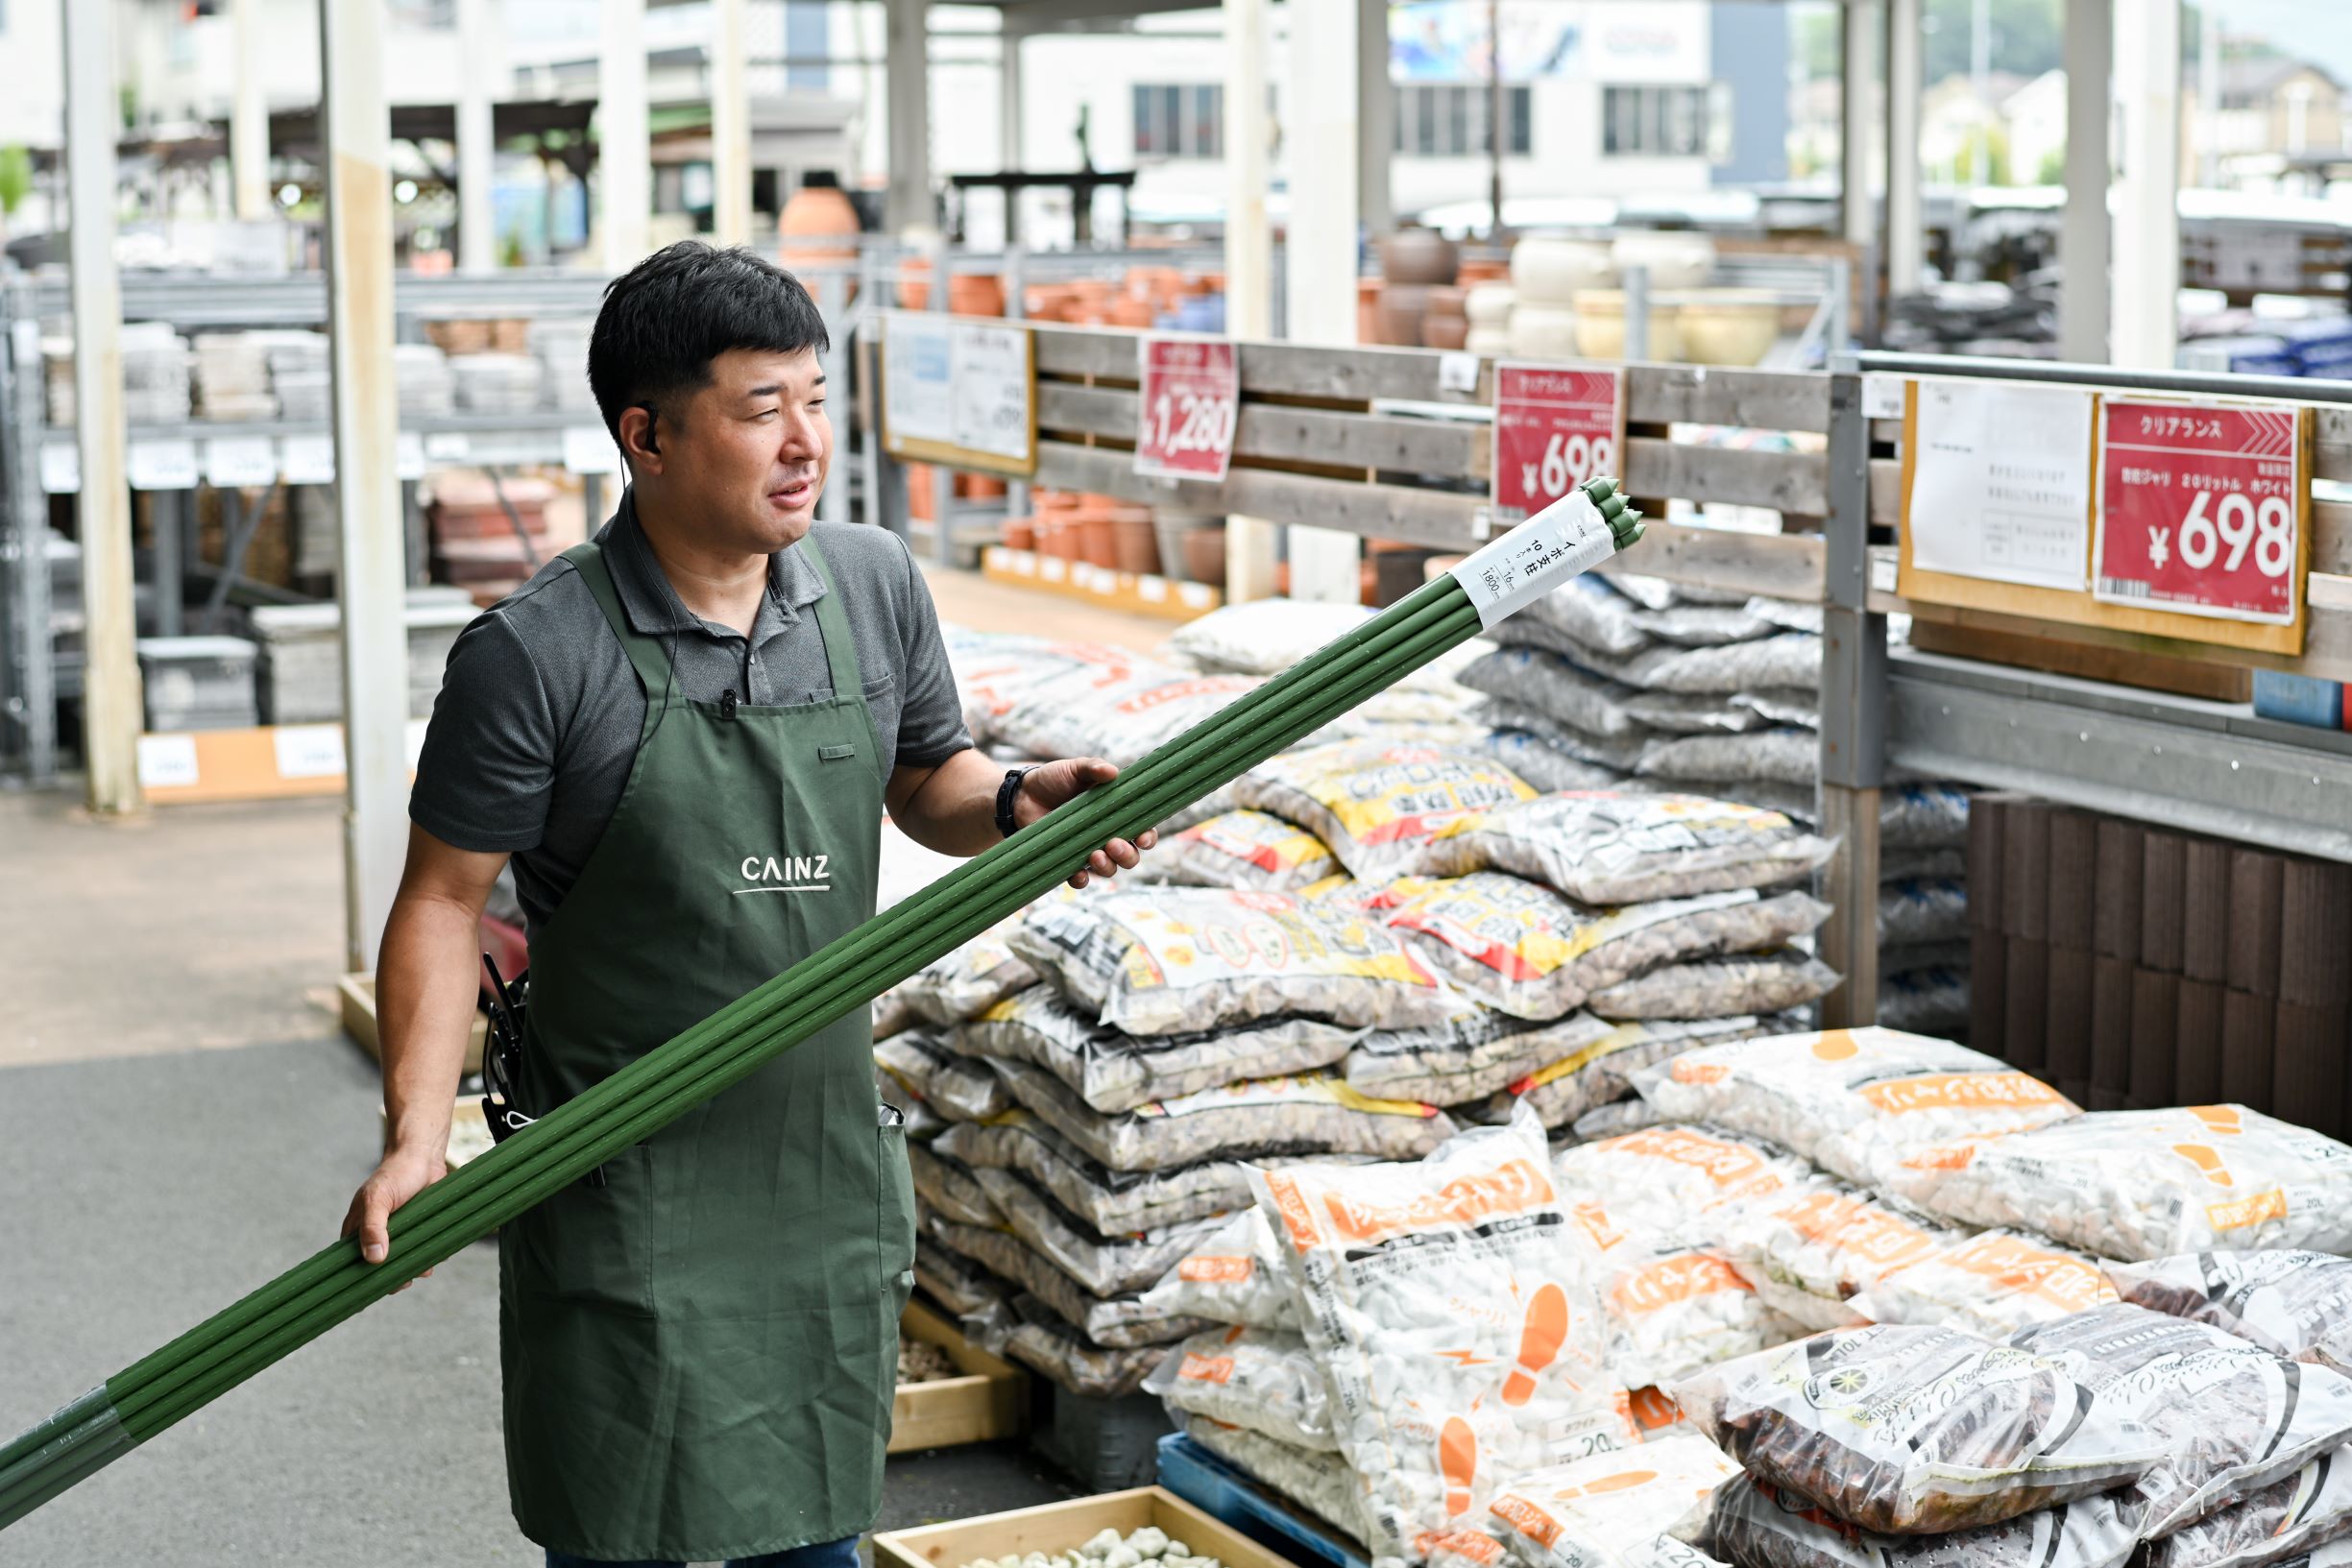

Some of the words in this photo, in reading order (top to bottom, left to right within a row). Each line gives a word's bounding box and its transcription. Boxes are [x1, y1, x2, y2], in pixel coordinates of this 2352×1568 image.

[2141, 415, 2223, 439] クリアランス
[2147, 491, 2291, 578] ¥698
[1523, 541, 1576, 576] イボ支柱
[740, 855, 830, 881] CAINZ
